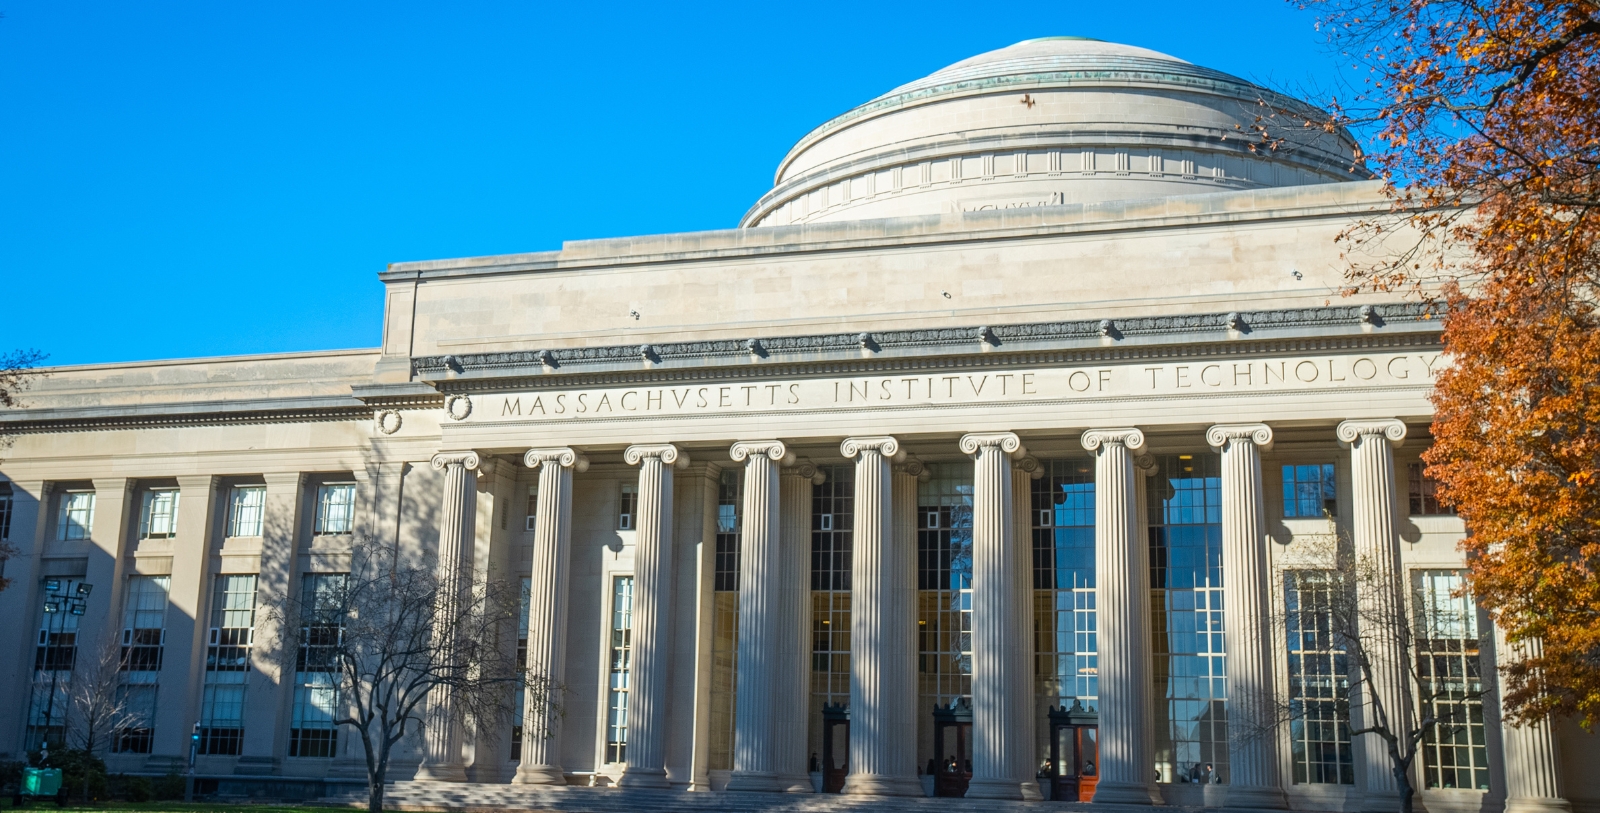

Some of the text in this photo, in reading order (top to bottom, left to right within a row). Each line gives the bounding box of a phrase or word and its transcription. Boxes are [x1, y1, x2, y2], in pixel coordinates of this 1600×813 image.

[502, 355, 1439, 416] MASSACHVSETTS INSTITVTE OF TECHNOLOGY
